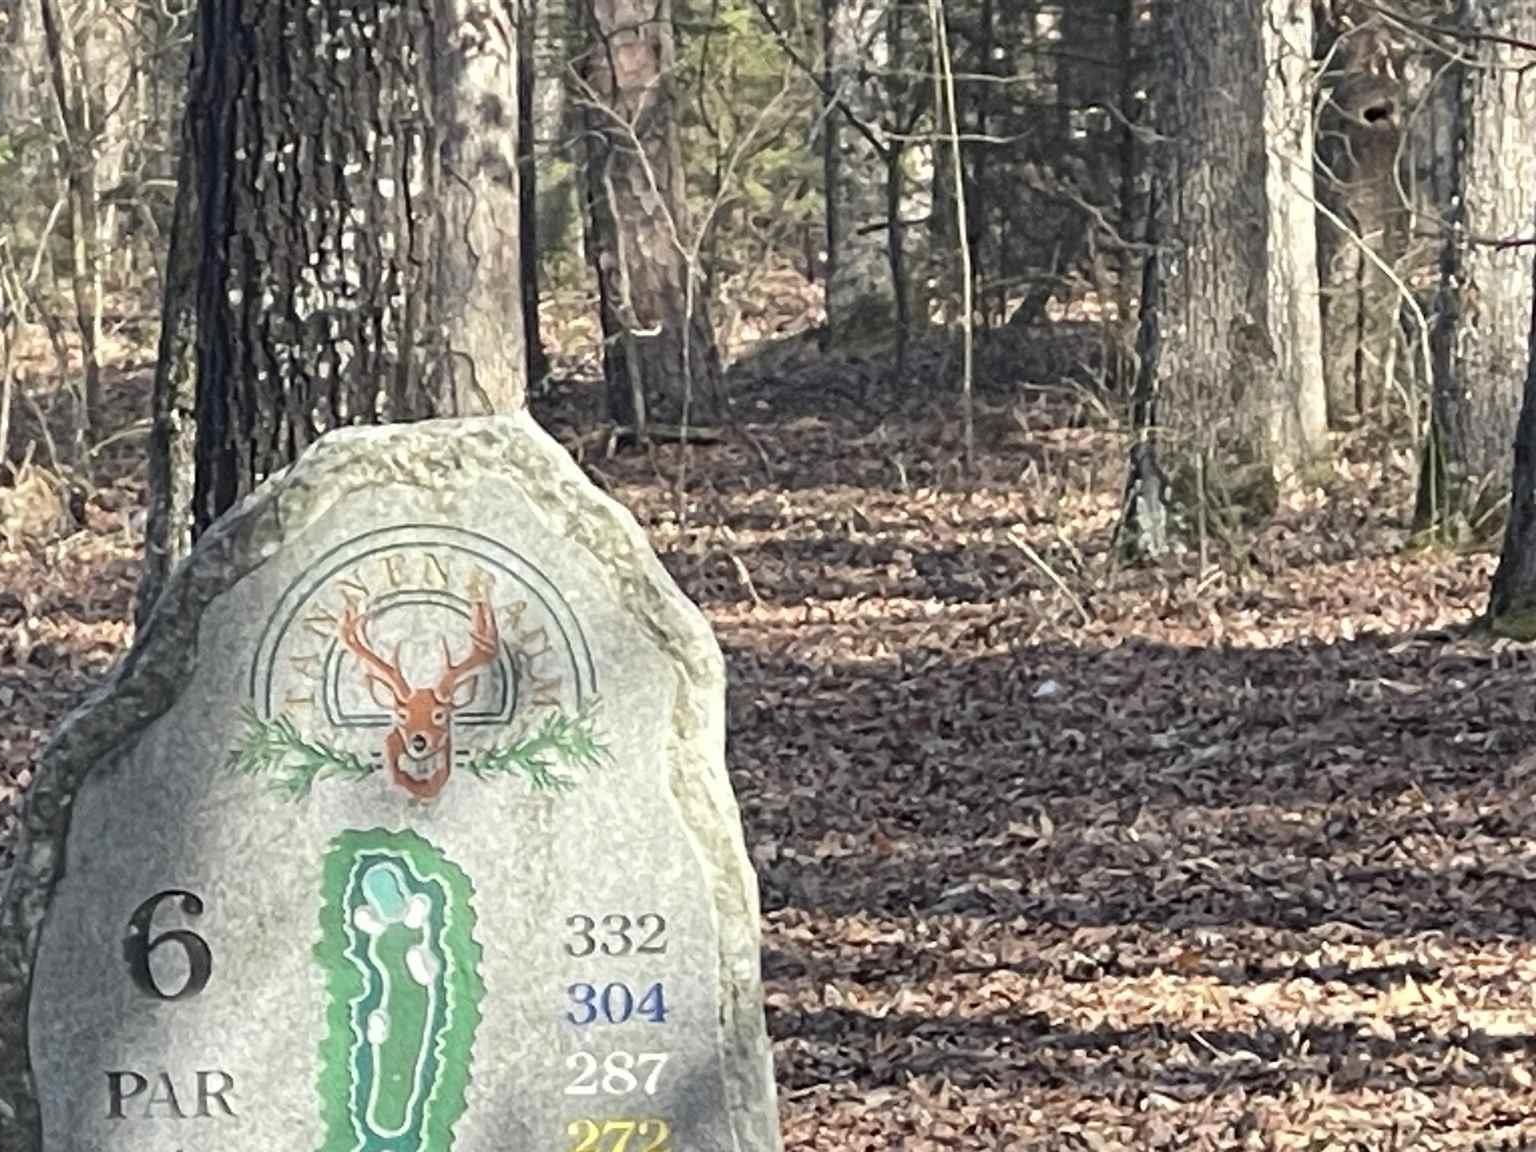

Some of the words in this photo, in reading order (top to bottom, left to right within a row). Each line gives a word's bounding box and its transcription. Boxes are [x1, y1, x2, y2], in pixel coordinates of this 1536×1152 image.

[123, 889, 212, 1001] 6
[565, 913, 668, 957] 332
[567, 982, 669, 1025] 304
[105, 1070, 237, 1119] PAR
[565, 1051, 670, 1095] 287
